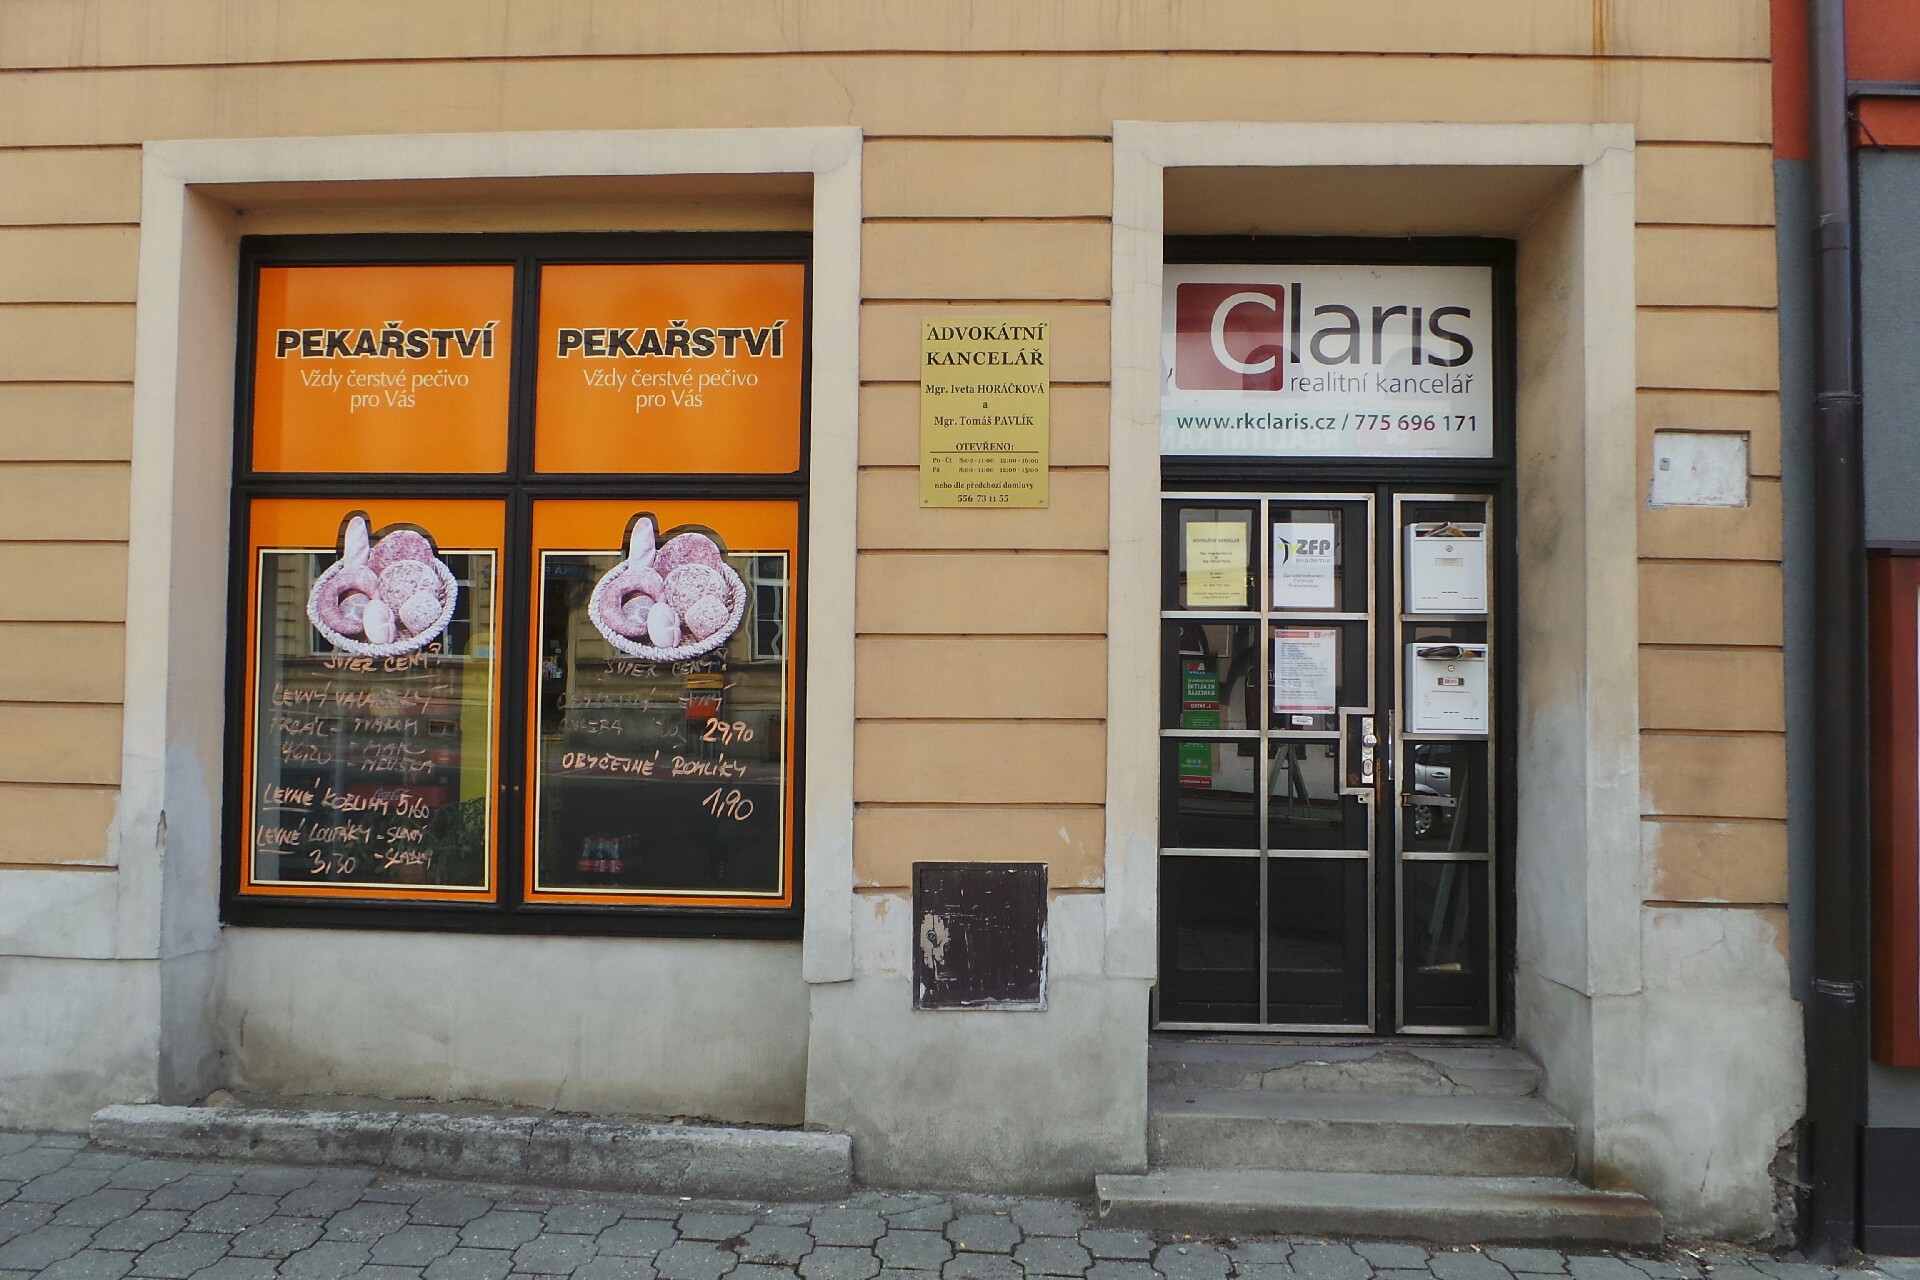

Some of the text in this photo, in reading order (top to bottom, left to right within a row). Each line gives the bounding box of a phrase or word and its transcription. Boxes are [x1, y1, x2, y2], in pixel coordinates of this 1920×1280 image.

[275, 320, 500, 359] PEKAŘSTVÍ
[557, 319, 789, 359] PEKAŘSTVÍ
[926, 323, 1044, 340] ADVOKÁTNÍ
[1210, 282, 1474, 374] Claris
[926, 348, 1044, 365] KANCELÁŘ
[300, 368, 469, 392] Vždy čerstvé pečivo
[583, 368, 758, 392] Vždy čerstvé pečivo
[925, 382, 1044, 395] Mgr. Iveta HORÁČKOVÁ
[1290, 372, 1474, 394] realitní kancelář
[350, 389, 416, 413] pro Vás
[636, 389, 703, 413] pro Vás
[934, 414, 1034, 428] Mgr. Tomáš PAVLÍK
[1177, 412, 1336, 430] www.rkclaris.cz
[1354, 414, 1391, 431] 775
[1399, 414, 1436, 431] 696
[1442, 414, 1476, 431] 171
[1003, 482, 1033, 490] domluvy
[1296, 540, 1330, 555] ZFP
[702, 787, 754, 821] 1,90
